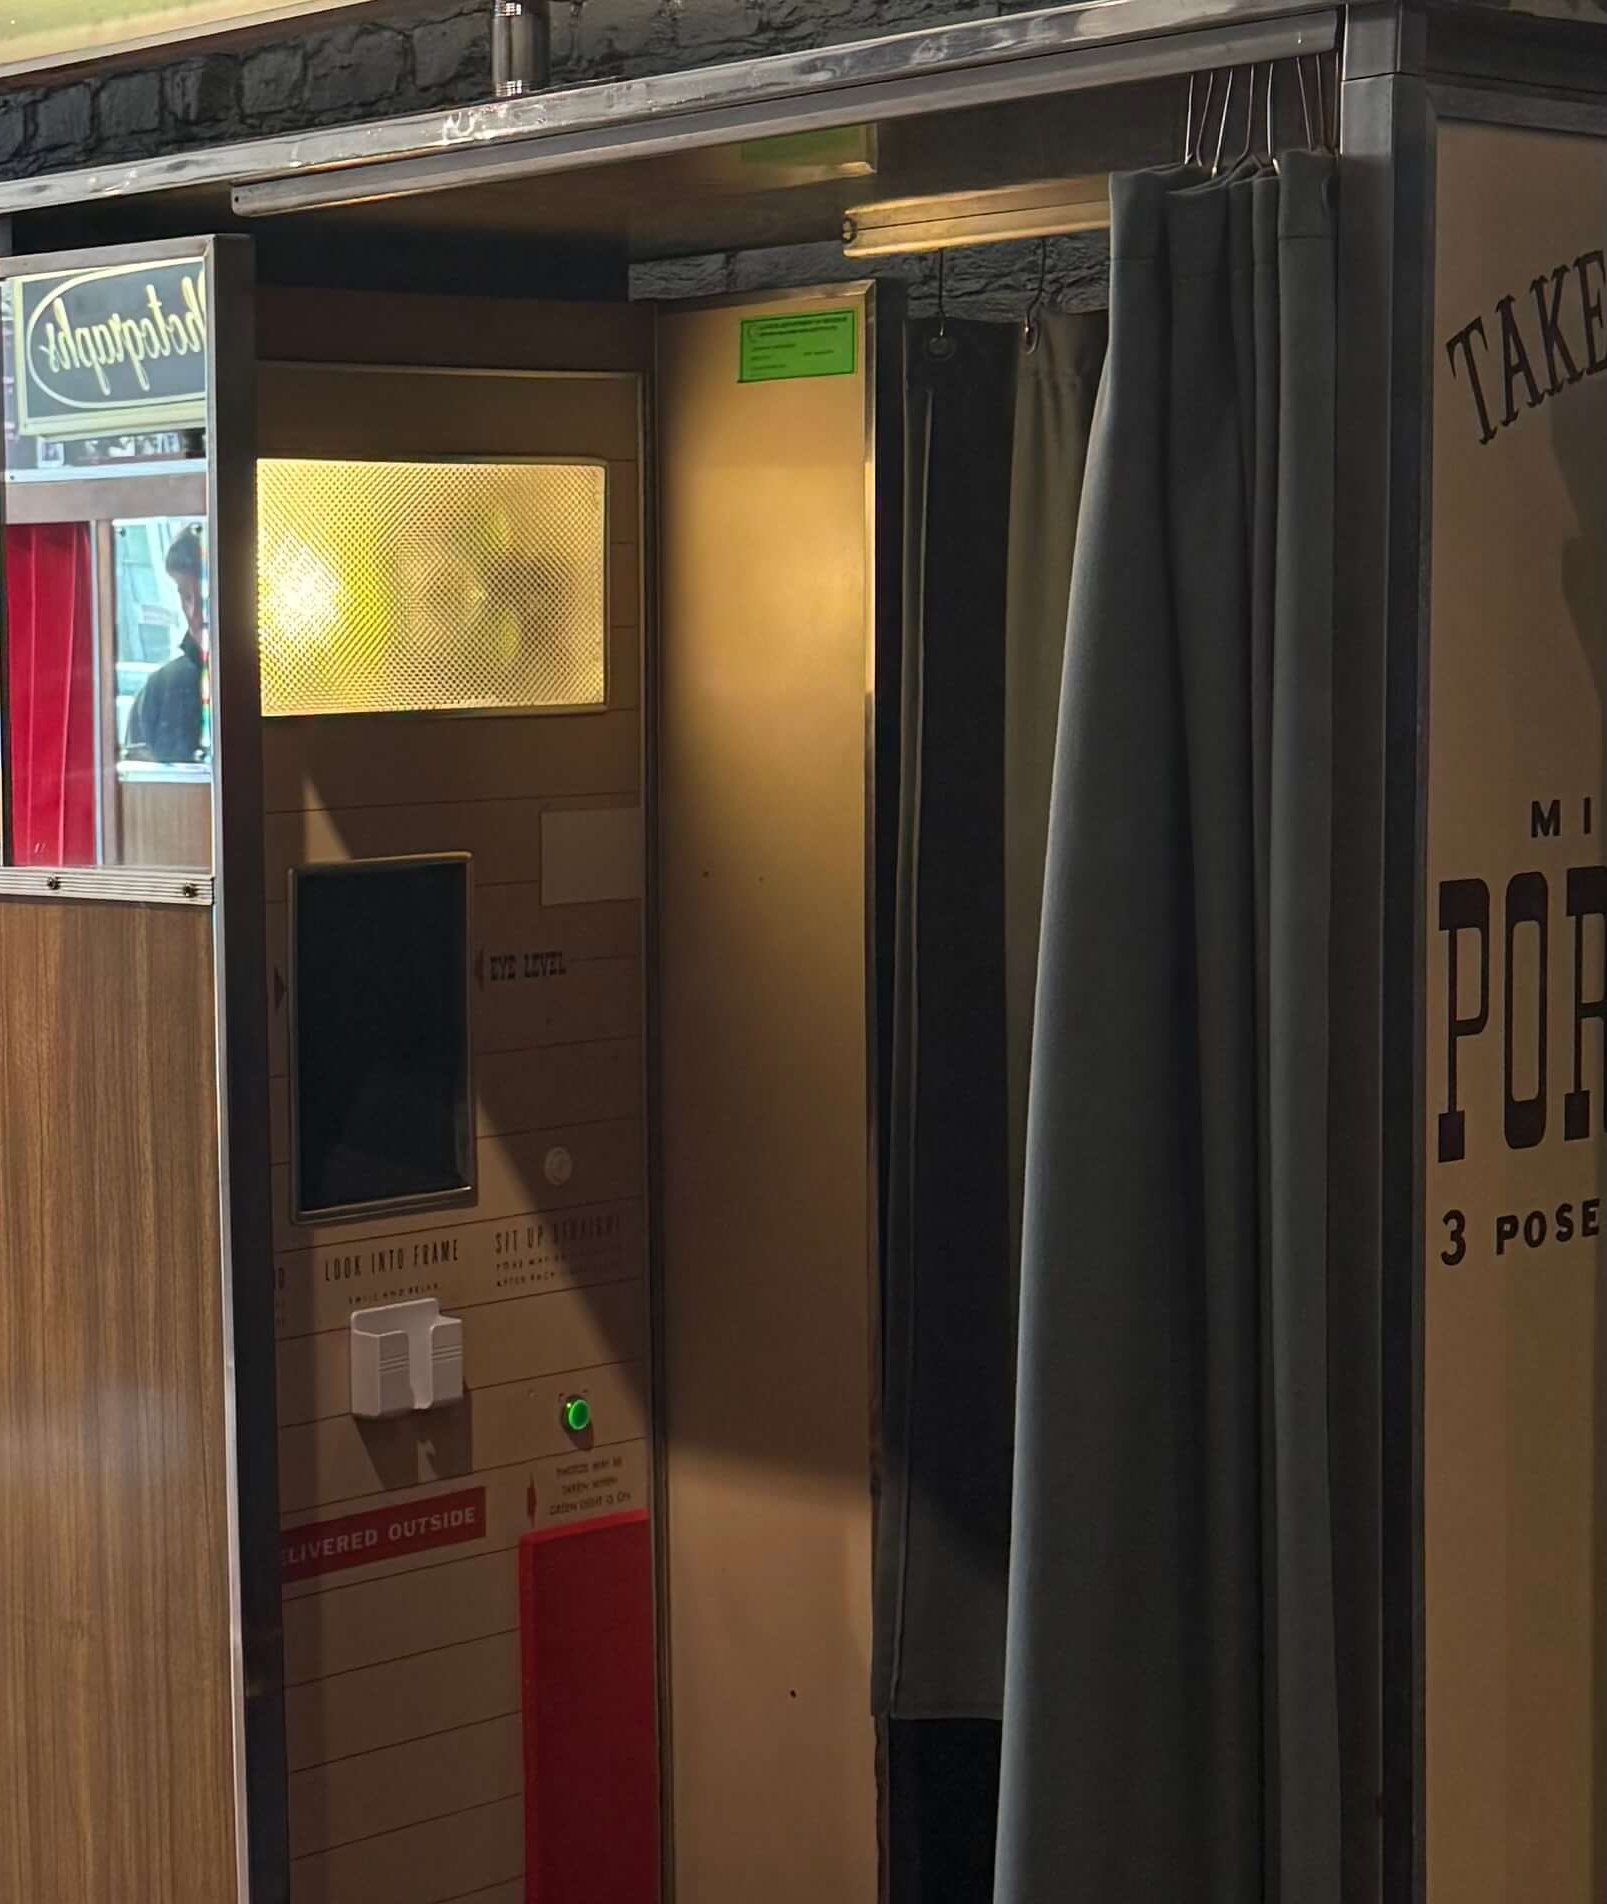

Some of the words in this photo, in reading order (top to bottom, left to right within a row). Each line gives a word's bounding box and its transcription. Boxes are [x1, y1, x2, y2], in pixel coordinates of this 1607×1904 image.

[1445, 249, 1607, 446] TAKE
[490, 954, 515, 981] EYE
[496, 1229, 517, 1254] SIT
[527, 1224, 543, 1248] UP
[1441, 1209, 1466, 1267] 3
[325, 1256, 361, 1282] LOOK
[371, 1248, 404, 1274] INTO
[413, 1239, 458, 1267] FRAME
[387, 1504, 476, 1543] OUTSIDE
